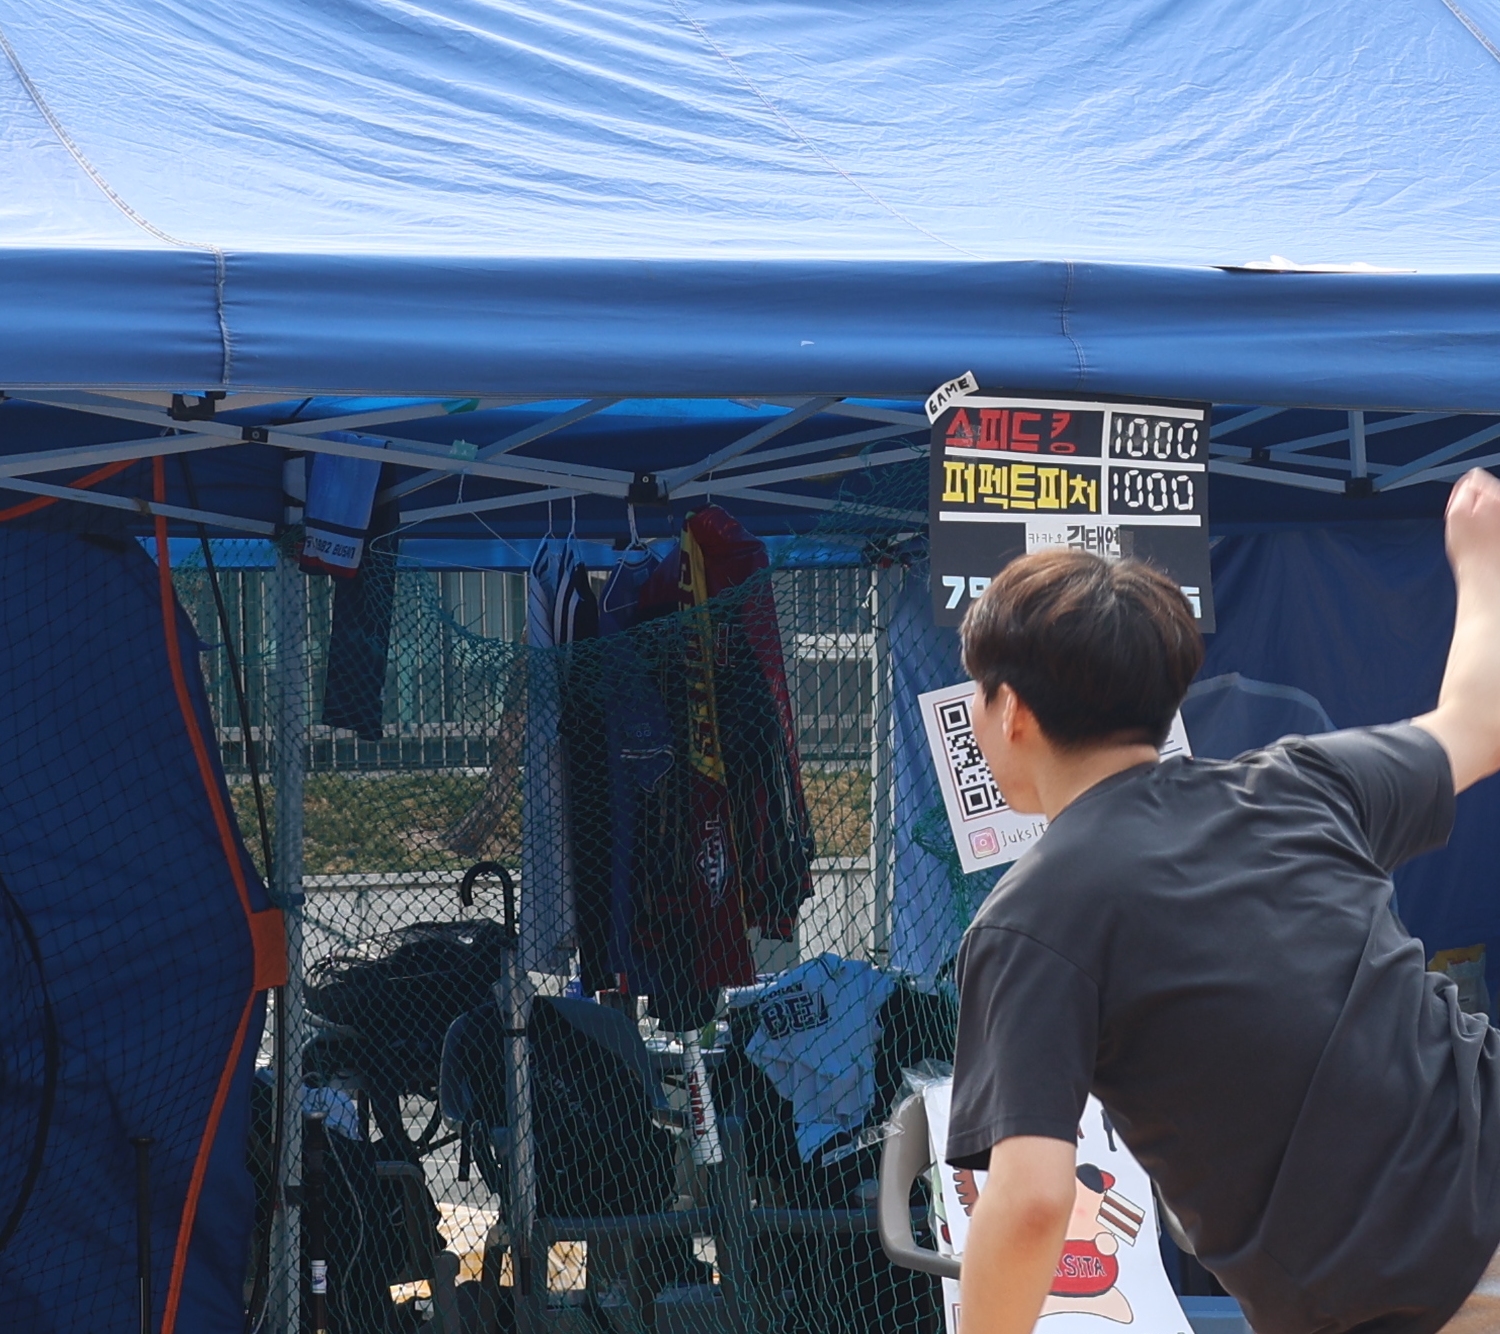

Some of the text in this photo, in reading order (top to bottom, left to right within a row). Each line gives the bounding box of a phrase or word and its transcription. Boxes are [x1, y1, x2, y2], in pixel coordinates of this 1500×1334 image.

[928, 377, 971, 416] GAME
[1116, 418, 1198, 459] 1000
[942, 461, 1194, 512] 퍼펙트피처 1000
[1028, 532, 1065, 545] 카카오
[1000, 821, 1051, 848] juksit
